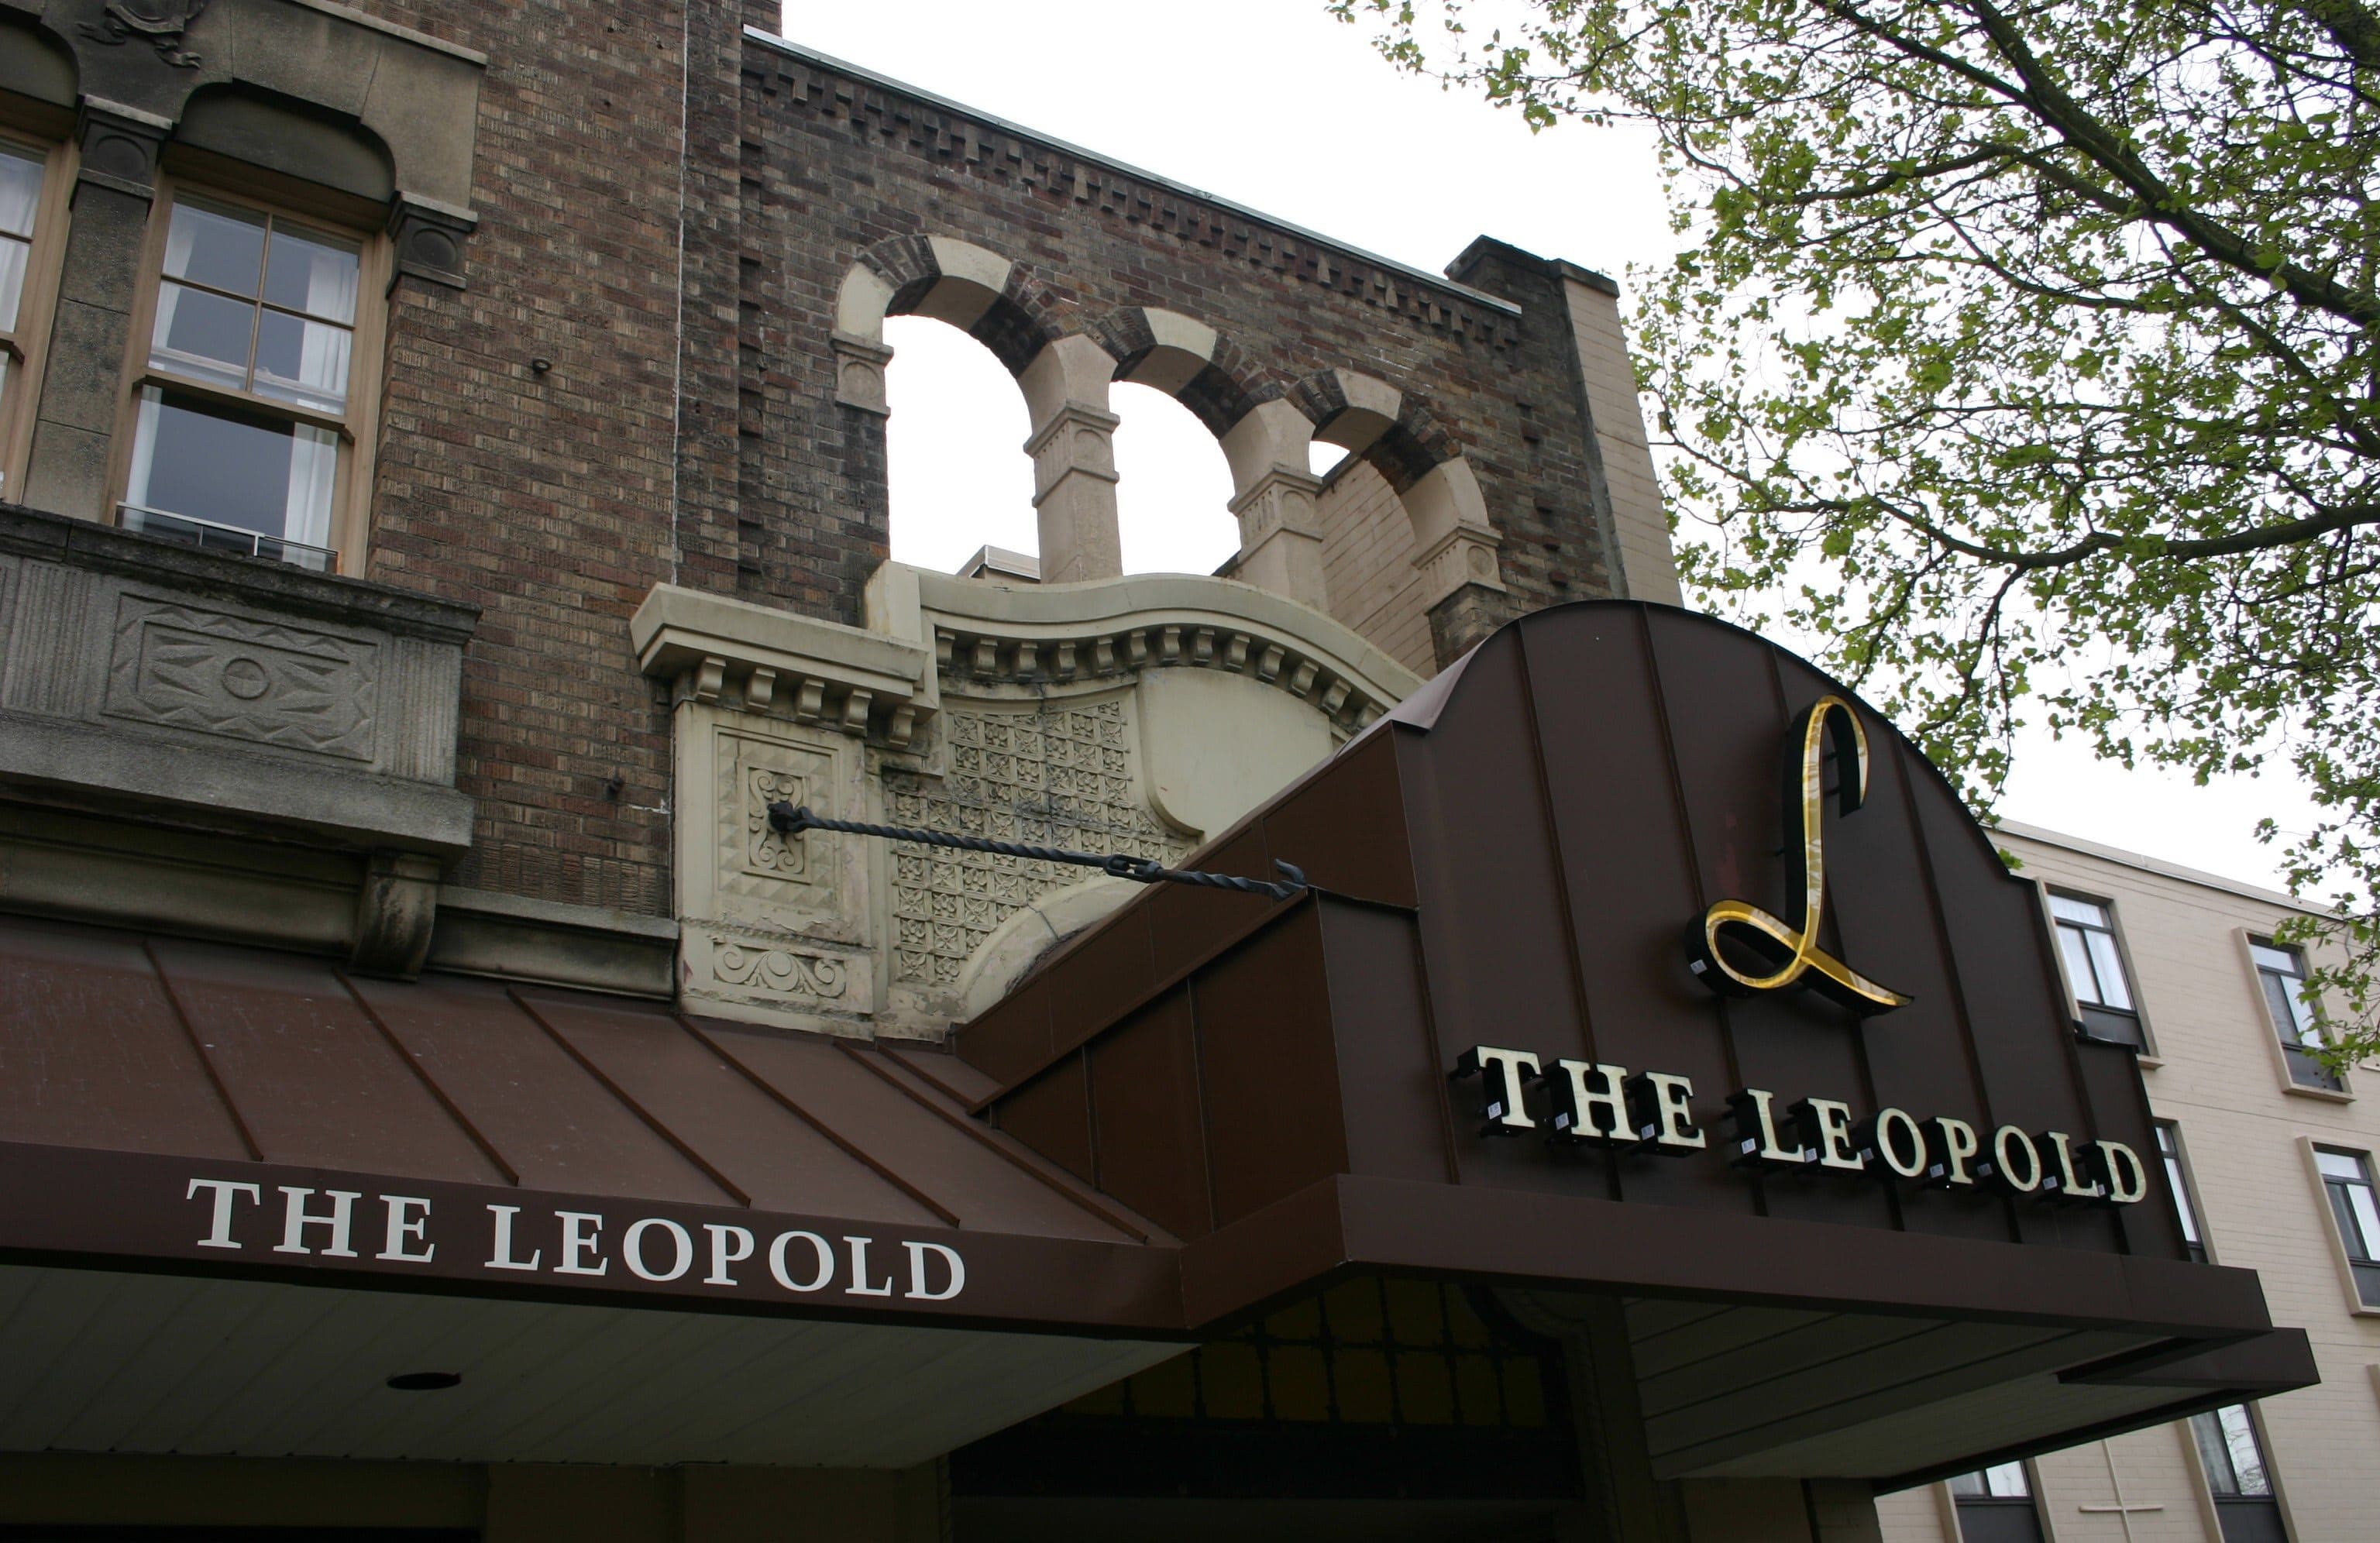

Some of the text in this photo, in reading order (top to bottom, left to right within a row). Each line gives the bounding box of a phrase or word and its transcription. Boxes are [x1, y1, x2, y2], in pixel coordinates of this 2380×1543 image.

[1705, 694, 1915, 1007] L
[1477, 1046, 2148, 1204] THE LEOPOLD
[186, 1178, 967, 1300] THE LEOPOLD
